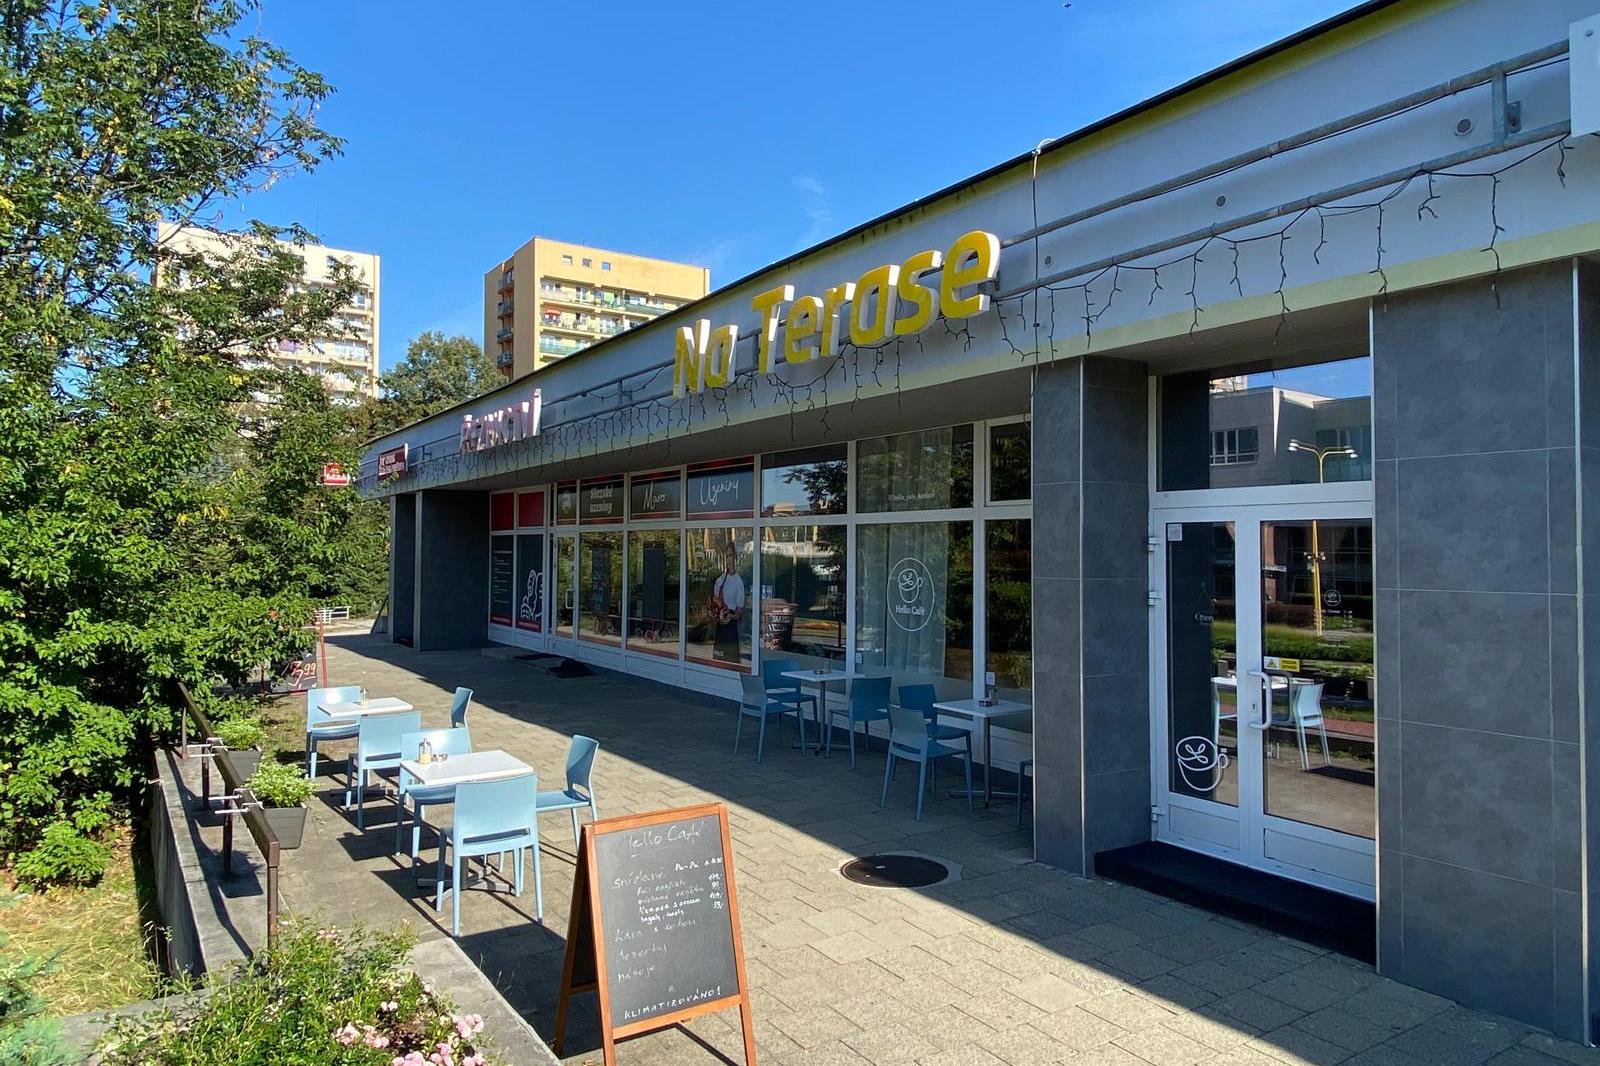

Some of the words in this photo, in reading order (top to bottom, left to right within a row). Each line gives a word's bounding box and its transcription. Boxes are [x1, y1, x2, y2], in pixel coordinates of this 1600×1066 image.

[752, 230, 1000, 374] Terase
[643, 480, 667, 510] Maso
[699, 477, 740, 506] Uzeniny
